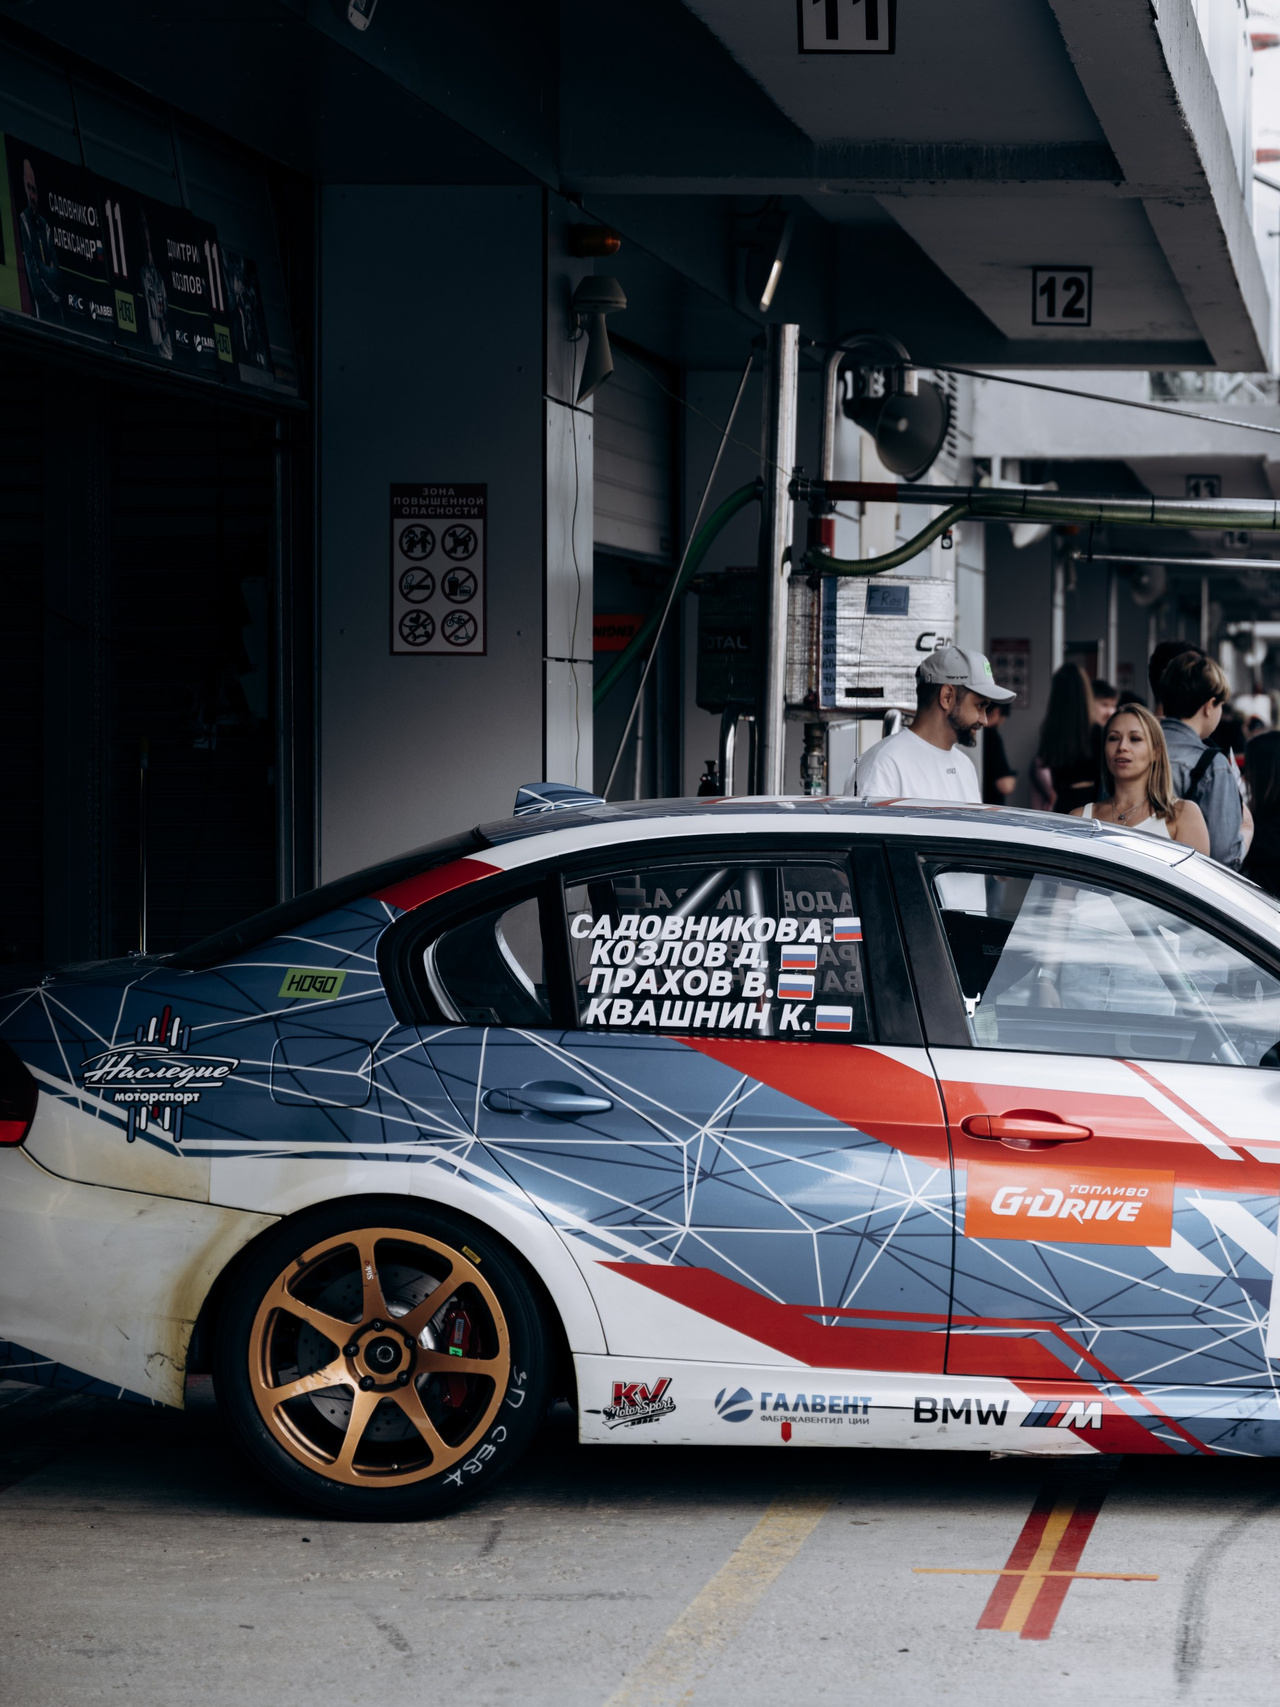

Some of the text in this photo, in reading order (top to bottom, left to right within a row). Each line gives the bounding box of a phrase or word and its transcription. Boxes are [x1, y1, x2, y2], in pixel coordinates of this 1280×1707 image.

[811, 0, 879, 41] 11
[104, 198, 129, 280] 11
[166, 238, 200, 264] ДМИТРИ
[203, 238, 226, 314] 11
[1039, 276, 1085, 318] 12
[393, 496, 484, 505] ПОВЫШЕННОЙ
[422, 487, 455, 496] ЗОНА
[402, 506, 479, 515] ОПАСНОСТИ
[589, 939, 769, 968] КОЗЛОВ Д.
[286, 974, 339, 994] HOGO
[587, 968, 774, 998] ПРАХОВ В.
[585, 998, 811, 1031] КВАШНИН К.
[82, 1052, 232, 1088] Наследие
[114, 1092, 200, 1104] моторспорт
[1069, 1184, 1149, 1197] ТОПЛИВО
[611, 1376, 673, 1407] KV
[760, 1392, 872, 1415] ГАЛВЕНТ
[848, 1417, 870, 1425] ЦИИ
[913, 1396, 1010, 1426] BMW
